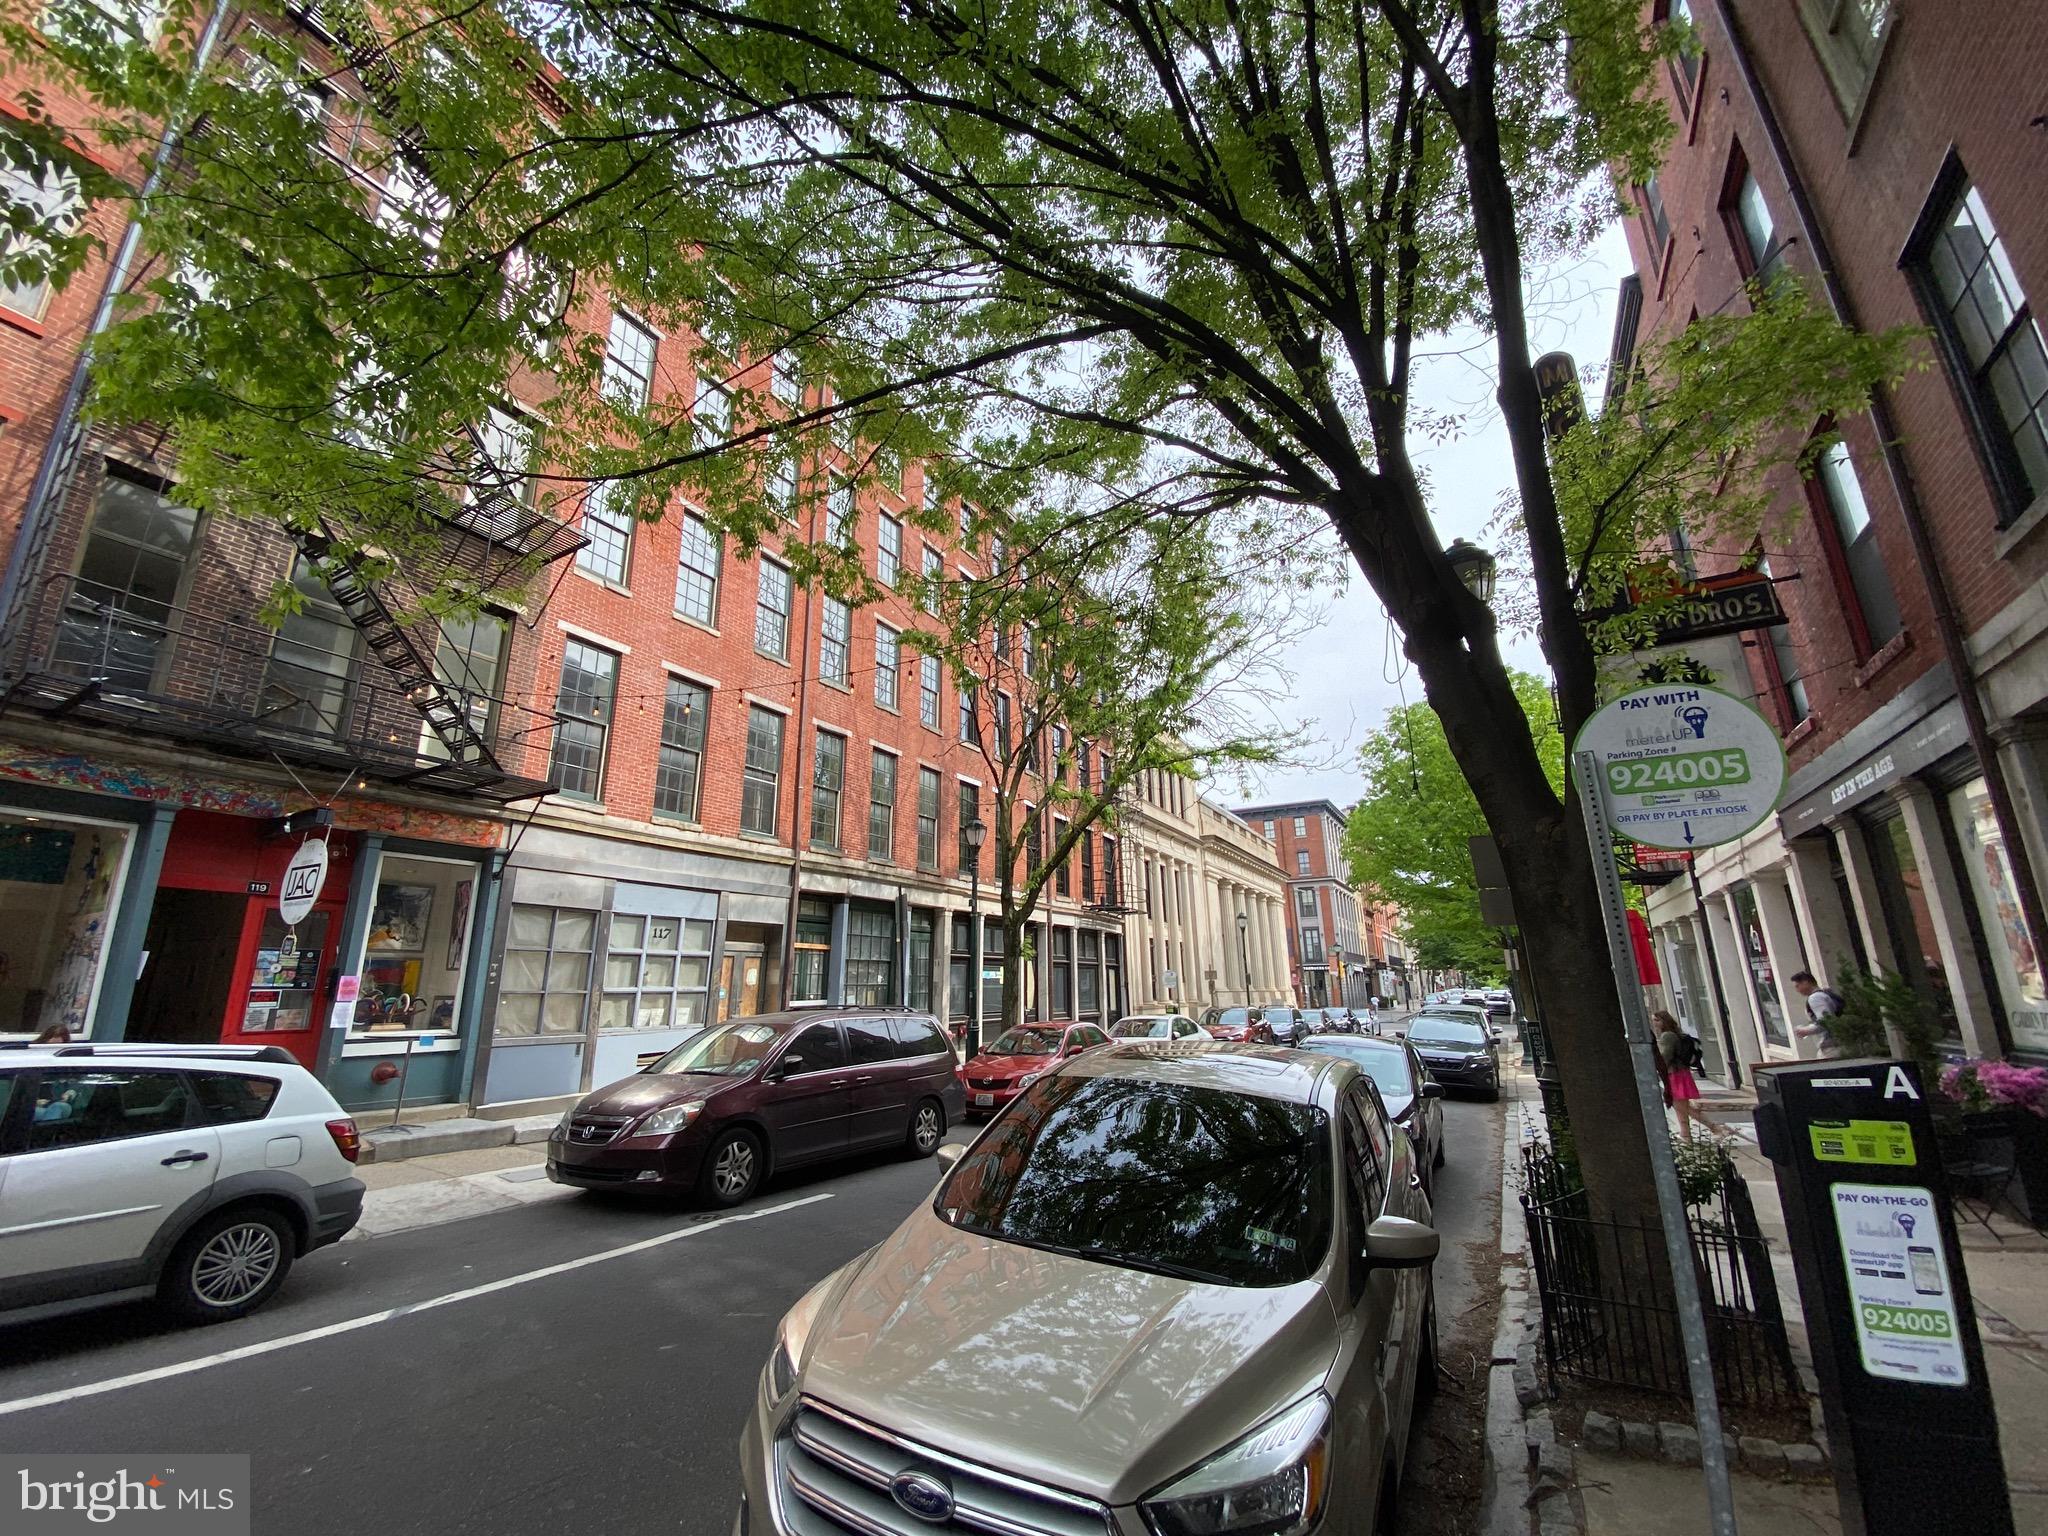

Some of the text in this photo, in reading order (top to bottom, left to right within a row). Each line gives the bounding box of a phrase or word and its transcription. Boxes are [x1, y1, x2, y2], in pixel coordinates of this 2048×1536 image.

[1620, 690, 1700, 710] PAY WITH
[1626, 727, 1692, 747] meterUP
[1607, 750, 1643, 759] Parking
[1644, 748, 1669, 756] Zone
[1609, 753, 1745, 790] 924005
[1831, 754, 1895, 805] ART IN THE AGE
[1617, 804, 1749, 823] OR PAY BY PLATE AT KIOSK
[251, 884, 267, 892] 119
[287, 868, 317, 897] JAC
[653, 927, 672, 939] 117
[1883, 1066, 1920, 1099] A
[1837, 1193, 1929, 1207] PAY ON-THE-GO
[1849, 1248, 1891, 1259] Download
[1858, 1294, 1887, 1305] Parking
[1864, 1307, 1949, 1333] 924005
